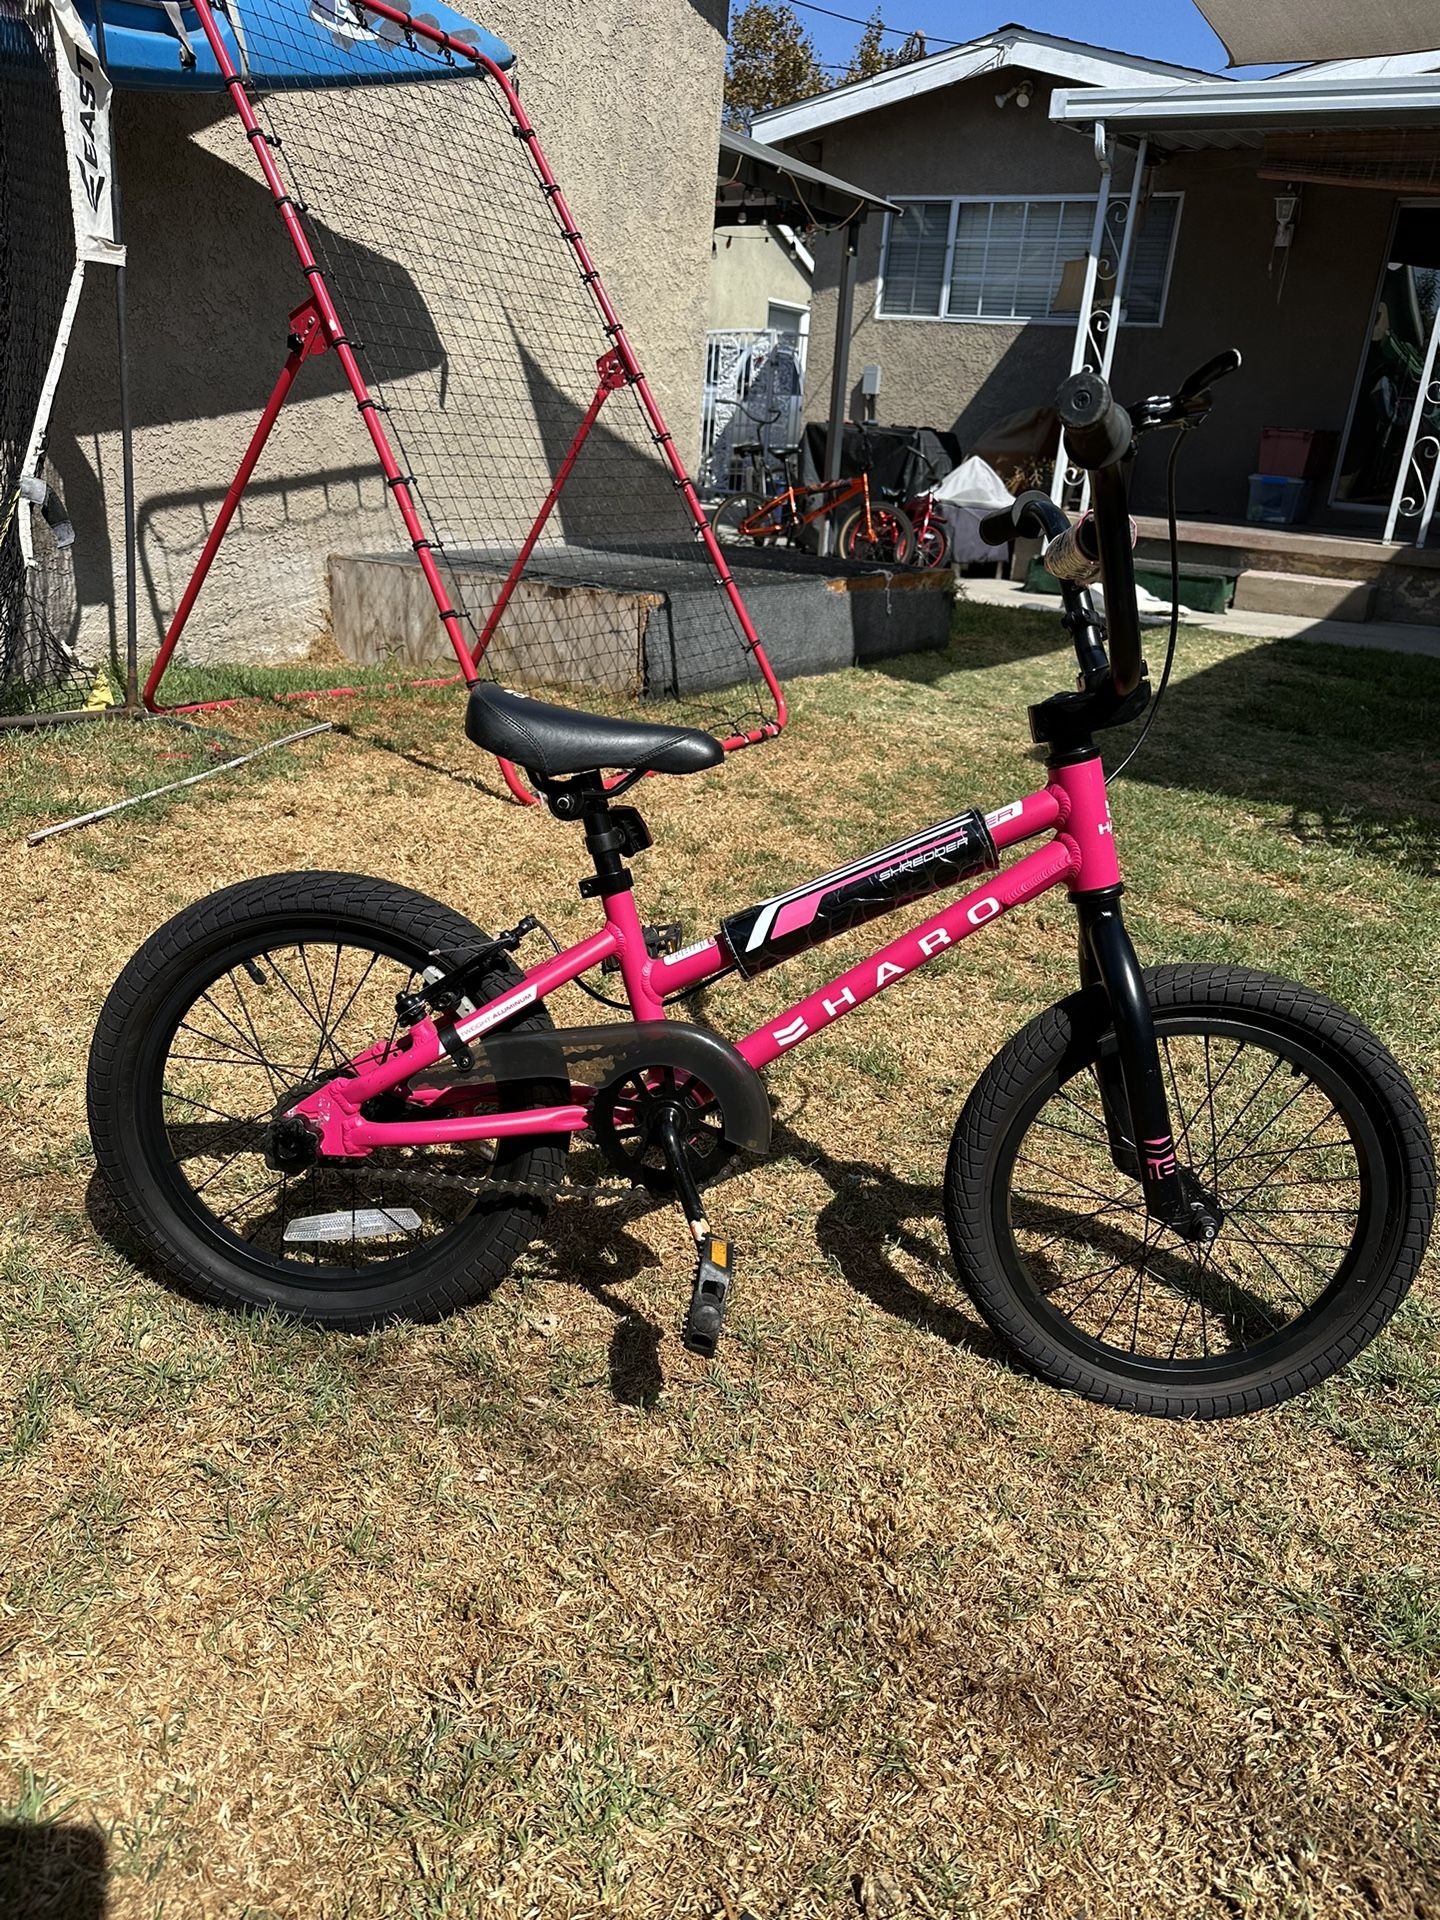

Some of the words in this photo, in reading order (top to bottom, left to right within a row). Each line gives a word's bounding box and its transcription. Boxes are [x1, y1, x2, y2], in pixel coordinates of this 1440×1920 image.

[878, 836, 969, 882] SHREDDER
[821, 896, 1001, 1017] HARO
[492, 994, 532, 1019] ALUMINUM
